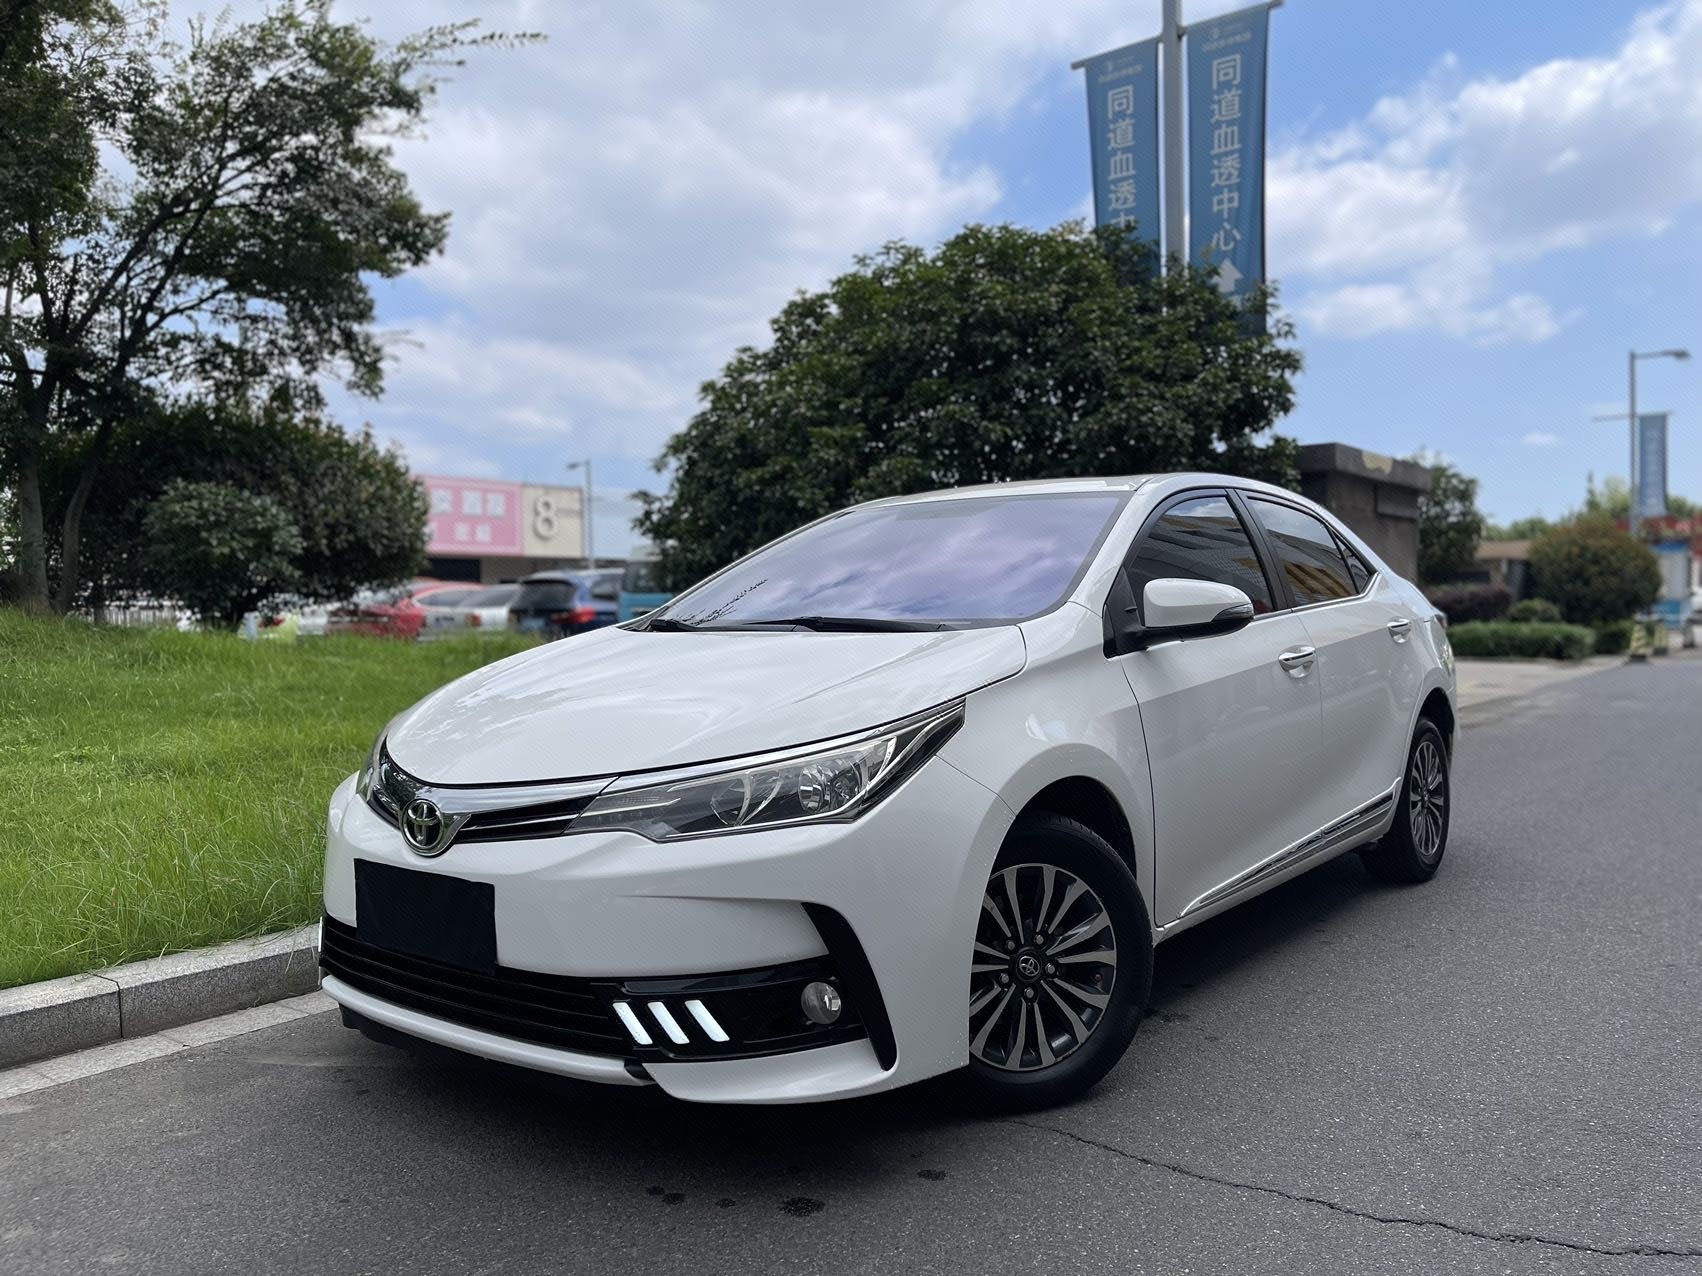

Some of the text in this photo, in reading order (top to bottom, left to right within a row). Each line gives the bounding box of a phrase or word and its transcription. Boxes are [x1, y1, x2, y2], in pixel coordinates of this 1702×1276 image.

[1210, 53, 1242, 251] 同道血透中心
